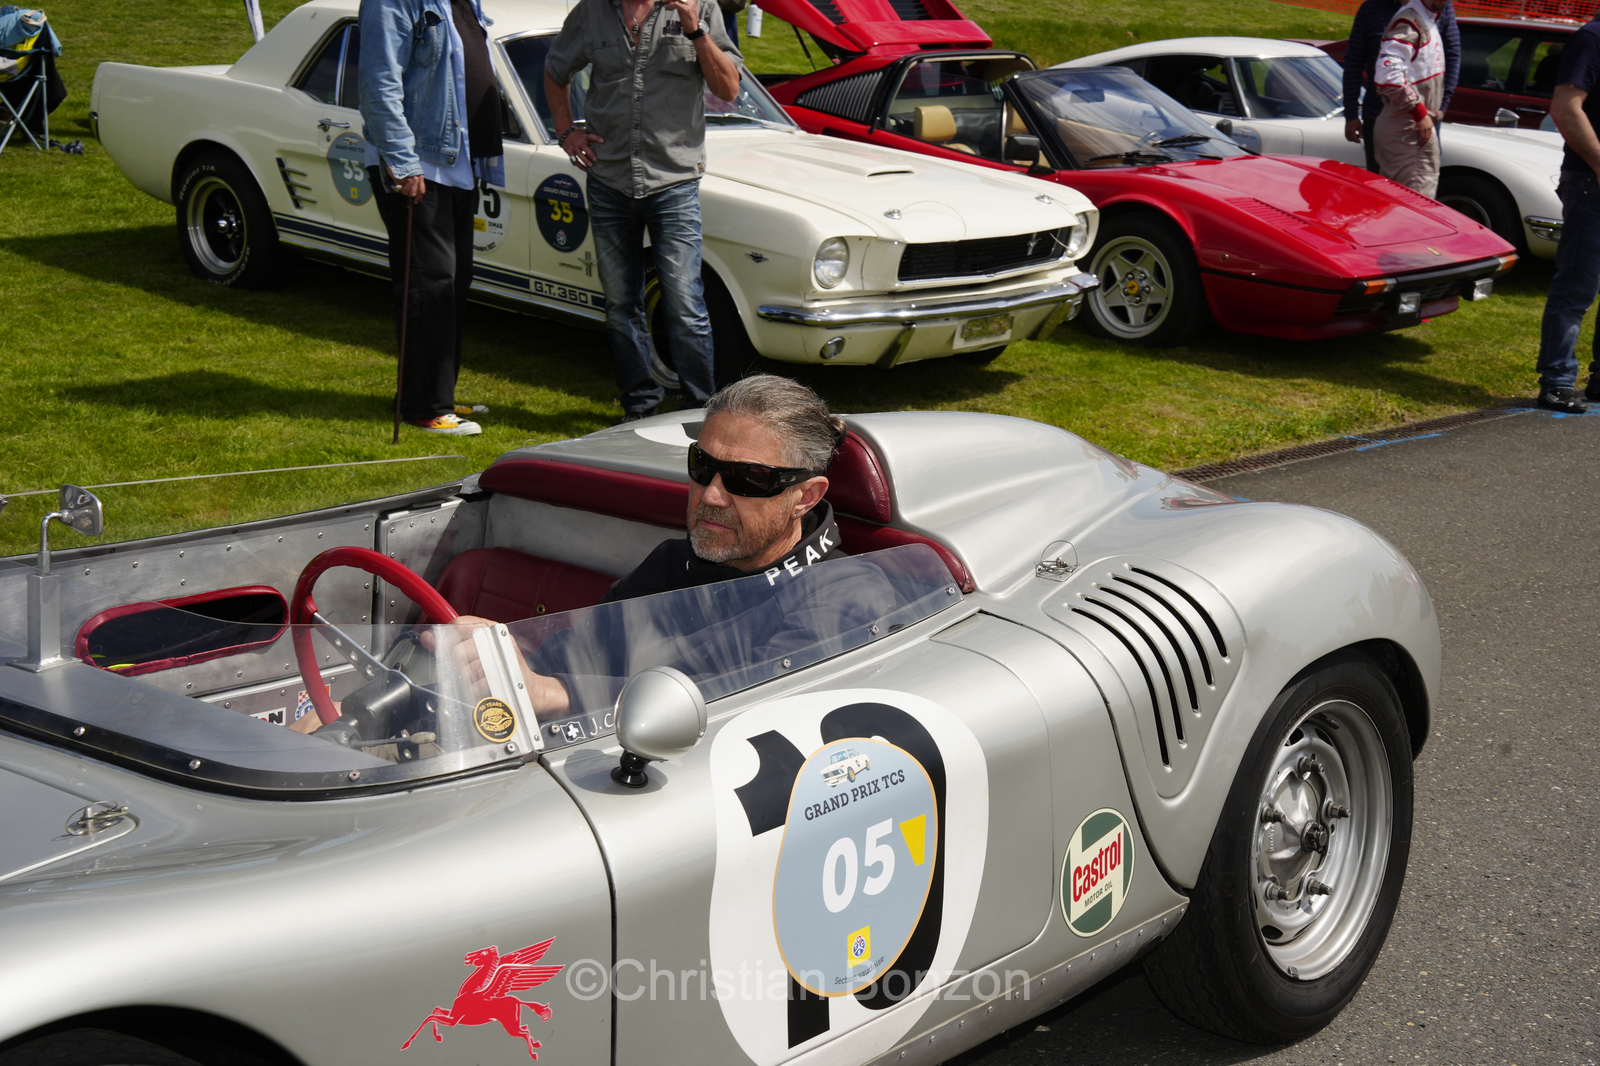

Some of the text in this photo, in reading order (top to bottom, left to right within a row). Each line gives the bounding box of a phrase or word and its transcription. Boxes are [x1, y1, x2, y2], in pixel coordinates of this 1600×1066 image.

[179, 164, 216, 201] Radial T/A
[339, 157, 365, 182] 35
[543, 186, 558, 195] GRAND
[558, 189, 570, 198] PRIX
[548, 198, 574, 224] 35
[764, 528, 833, 586] PEAK
[804, 769, 905, 821] GRAND PRIX TCS
[822, 817, 896, 914] 05
[1073, 832, 1121, 902] Castrol
[1084, 881, 1113, 908] MOTOR OIL
[834, 956, 885, 985] Section vaudoise
